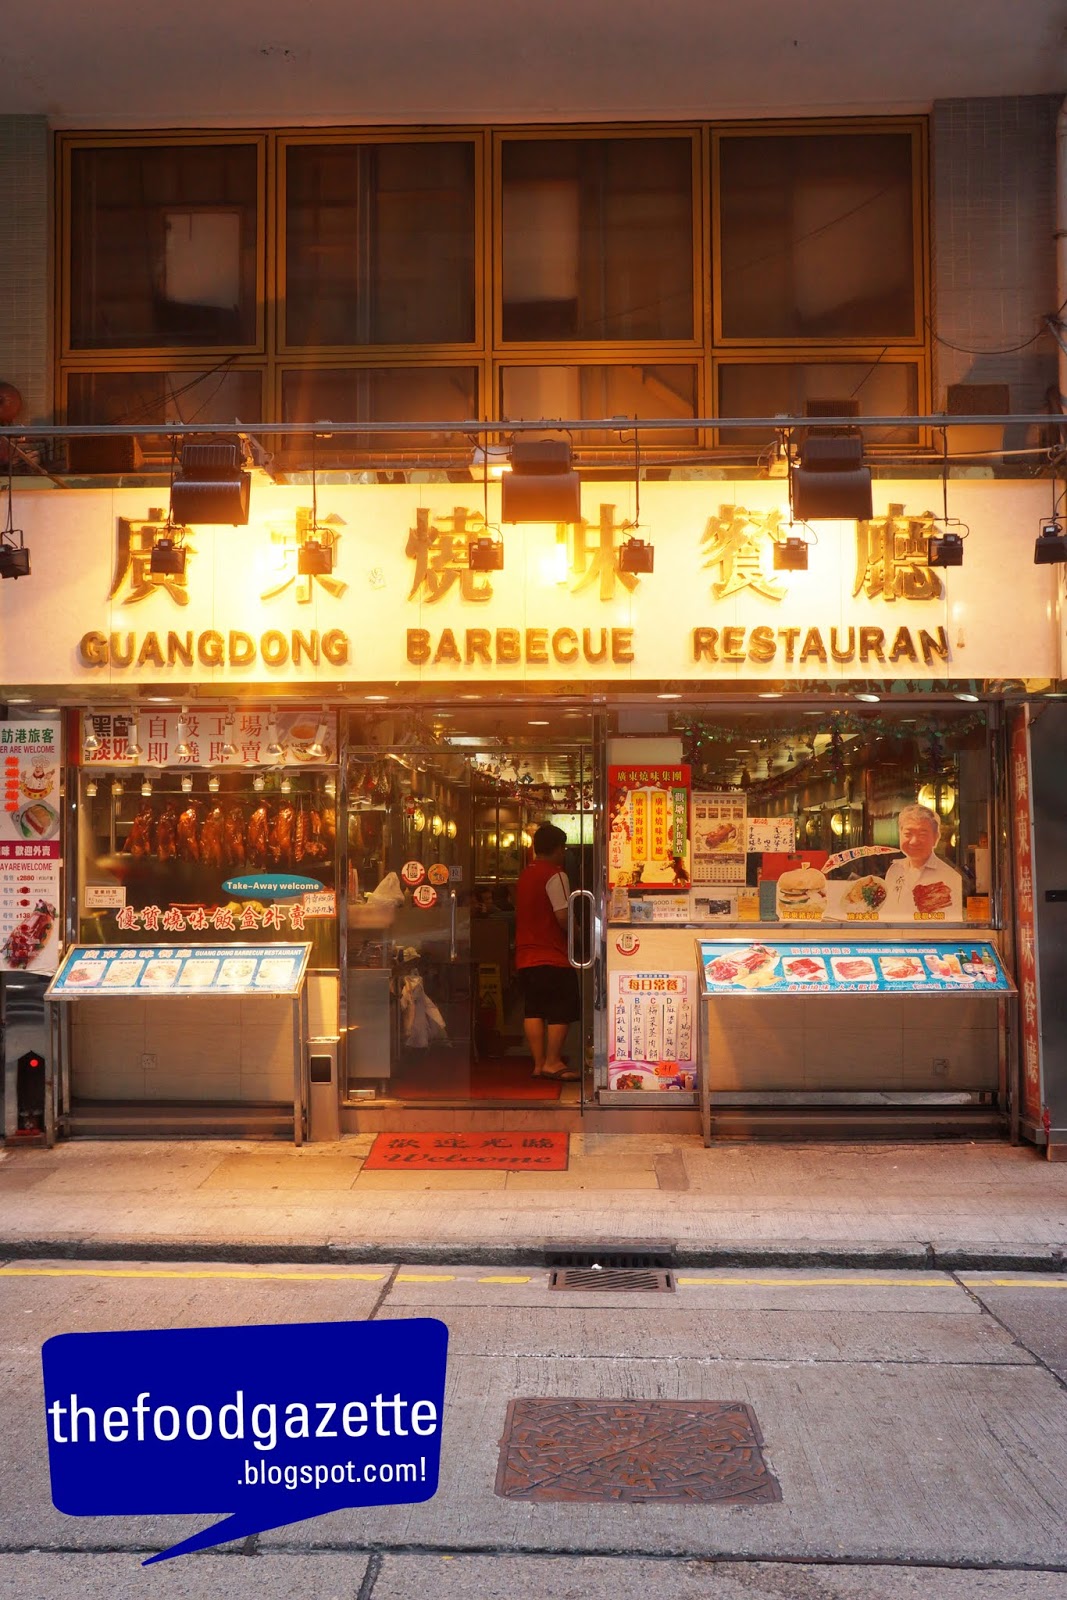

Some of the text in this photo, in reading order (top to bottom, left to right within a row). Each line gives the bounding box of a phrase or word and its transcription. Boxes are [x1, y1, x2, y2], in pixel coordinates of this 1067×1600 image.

[79, 625, 949, 667] GUANGDONG BARBECUE RESTAURAN
[1, 728, 54, 743] 訪港旅客
[23, 745, 55, 754] WELCOME
[279, 881, 320, 890] welcome
[116, 904, 306, 931] 優質燒味飯盒外賣
[628, 979, 679, 991] 每日常餐
[650, 997, 657, 1005] C
[666, 997, 673, 1005] D
[383, 1152, 553, 1164] Welcome
